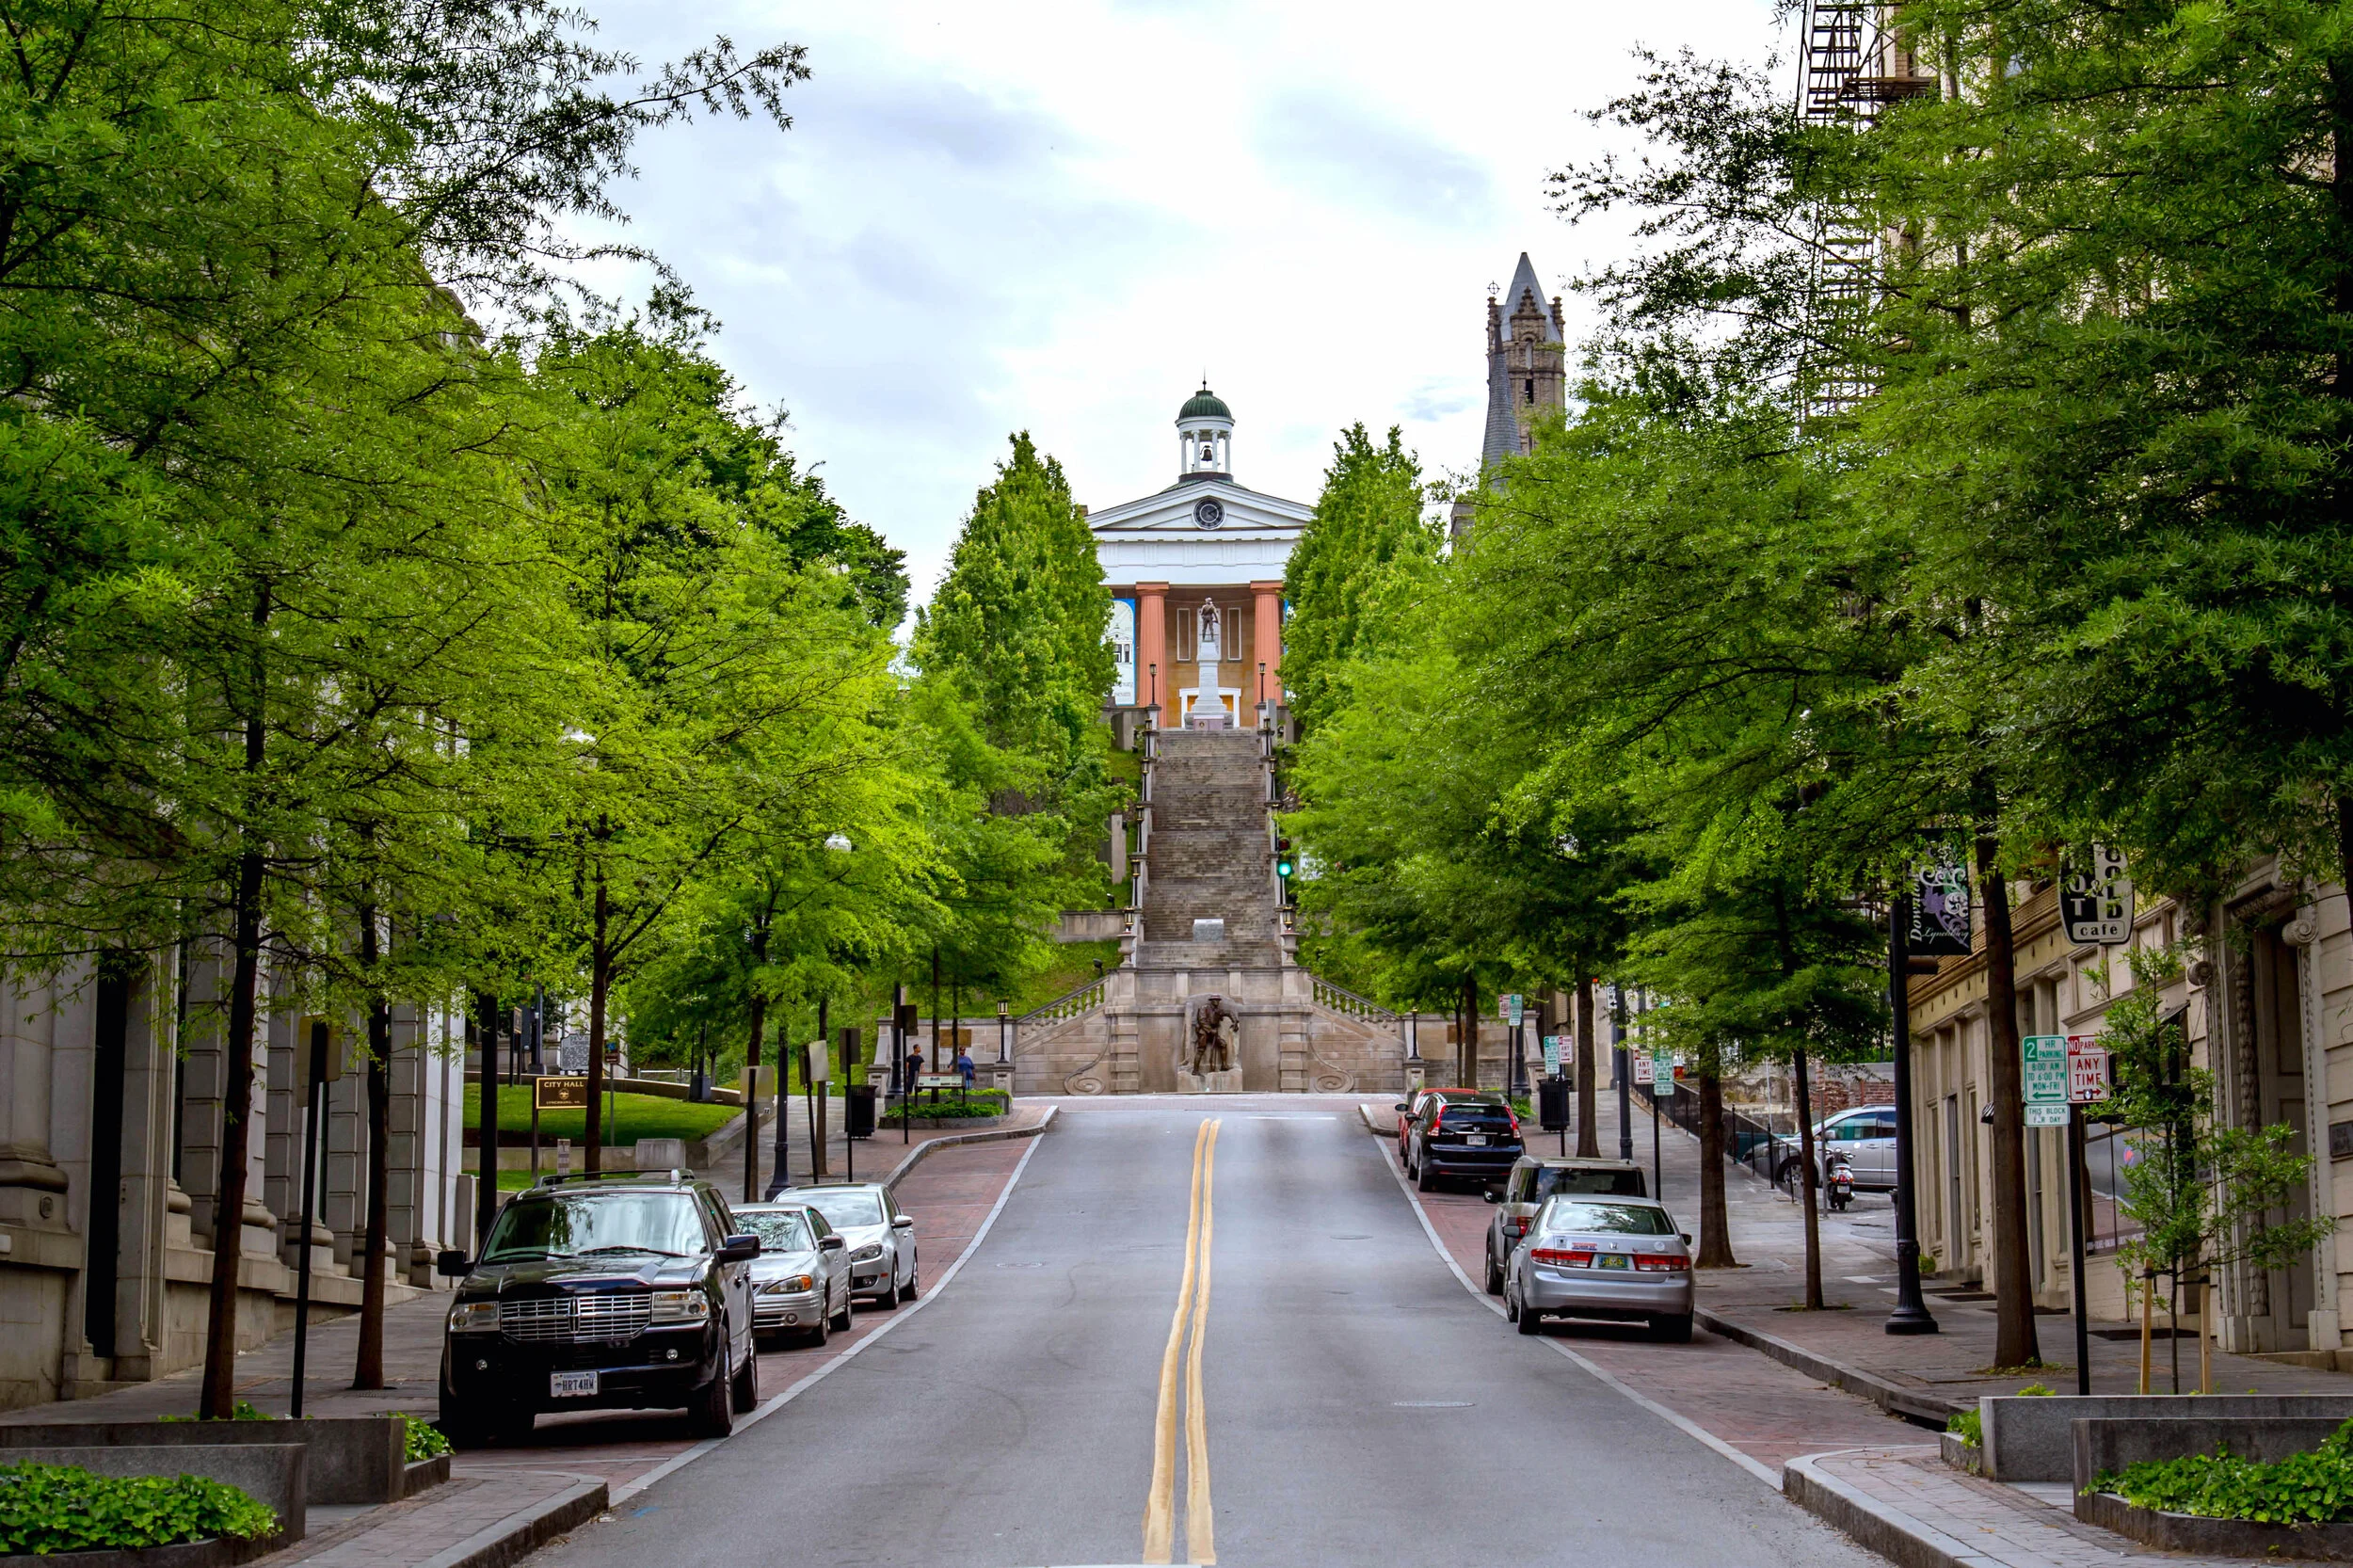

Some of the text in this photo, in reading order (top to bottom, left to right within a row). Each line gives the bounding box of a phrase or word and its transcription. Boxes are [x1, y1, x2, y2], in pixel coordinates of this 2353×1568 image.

[2044, 1040, 2056, 1048] HR
[2068, 1039, 2079, 1052] NO
[2026, 1042, 2036, 1058] 2
[2039, 1049, 2062, 1059] PARKING
[2050, 1062, 2060, 1070] AM
[2076, 1058, 2100, 1071] ANY
[2027, 1072, 2036, 1080] TO
[2056, 1071, 2065, 1080] PM
[2074, 1073, 2102, 1086] TIME
[2032, 1081, 2060, 1091] MON-FRI
[2028, 1107, 2042, 1115] THIS
[2050, 1115, 2061, 1124] DAY
